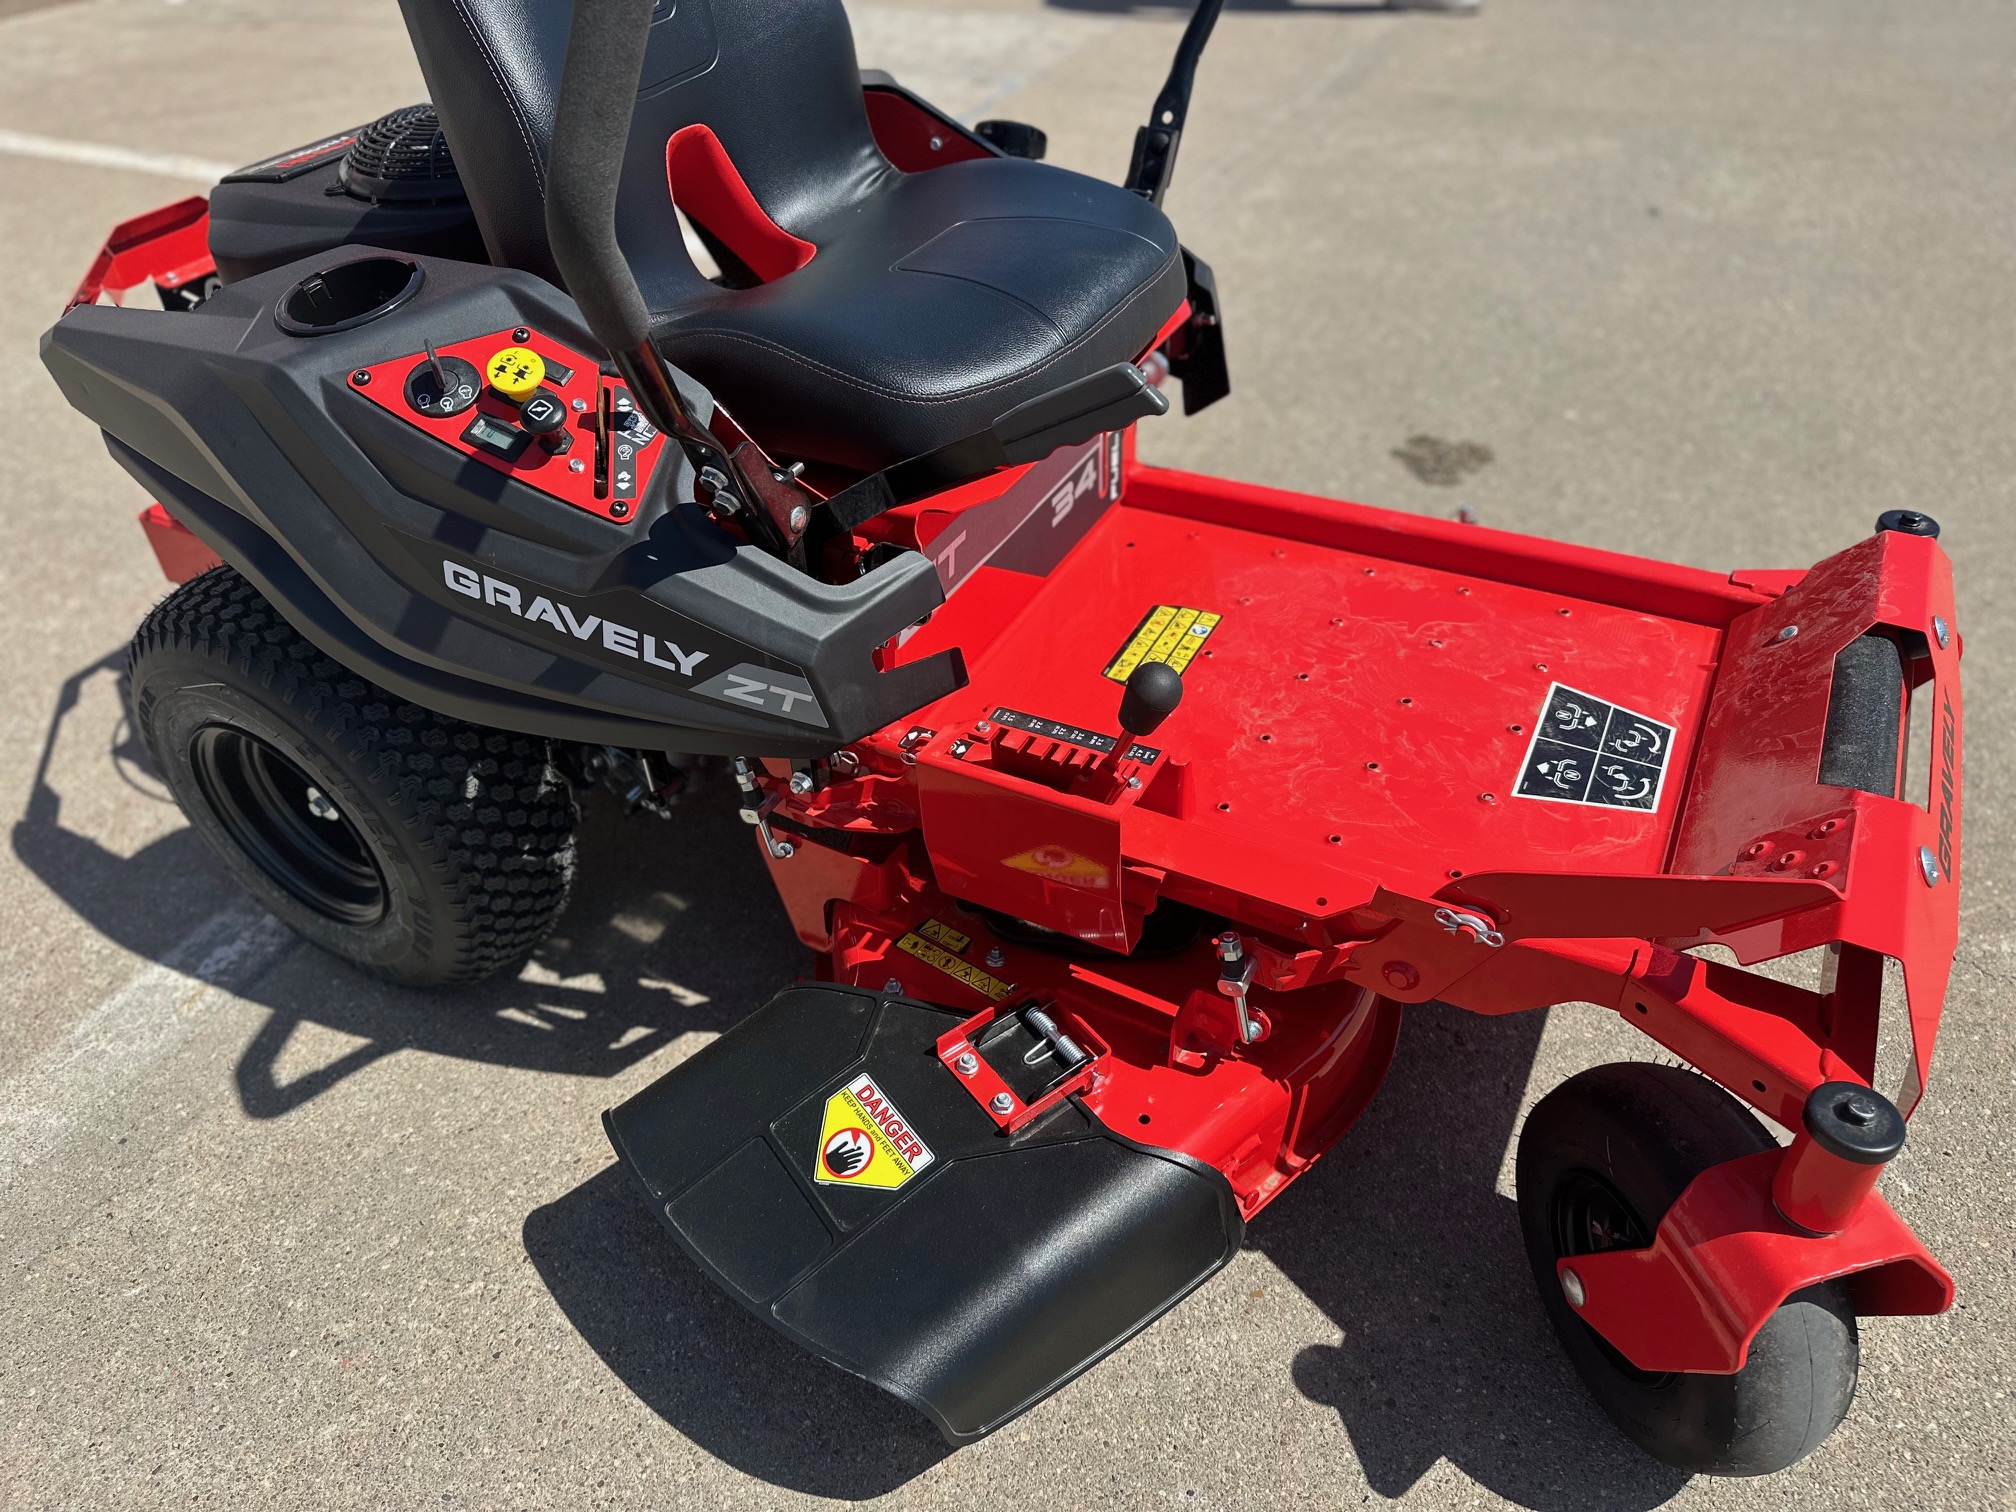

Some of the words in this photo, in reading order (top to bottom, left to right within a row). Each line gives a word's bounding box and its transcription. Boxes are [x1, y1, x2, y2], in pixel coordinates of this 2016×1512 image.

[1109, 433, 1120, 501] FUEL
[932, 529, 967, 579] T
[1051, 458, 1098, 528] 34
[443, 560, 709, 677] GRAVELY
[722, 673, 813, 712] ZT
[1938, 686, 1956, 883] GRAVELY
[840, 1091, 857, 1108] KEEP
[853, 1107, 874, 1130] HANDS
[870, 1129, 882, 1142] and
[880, 1141, 895, 1158] FEET
[892, 1156, 911, 1176] AWAY
[855, 1084, 923, 1164] DANGER
